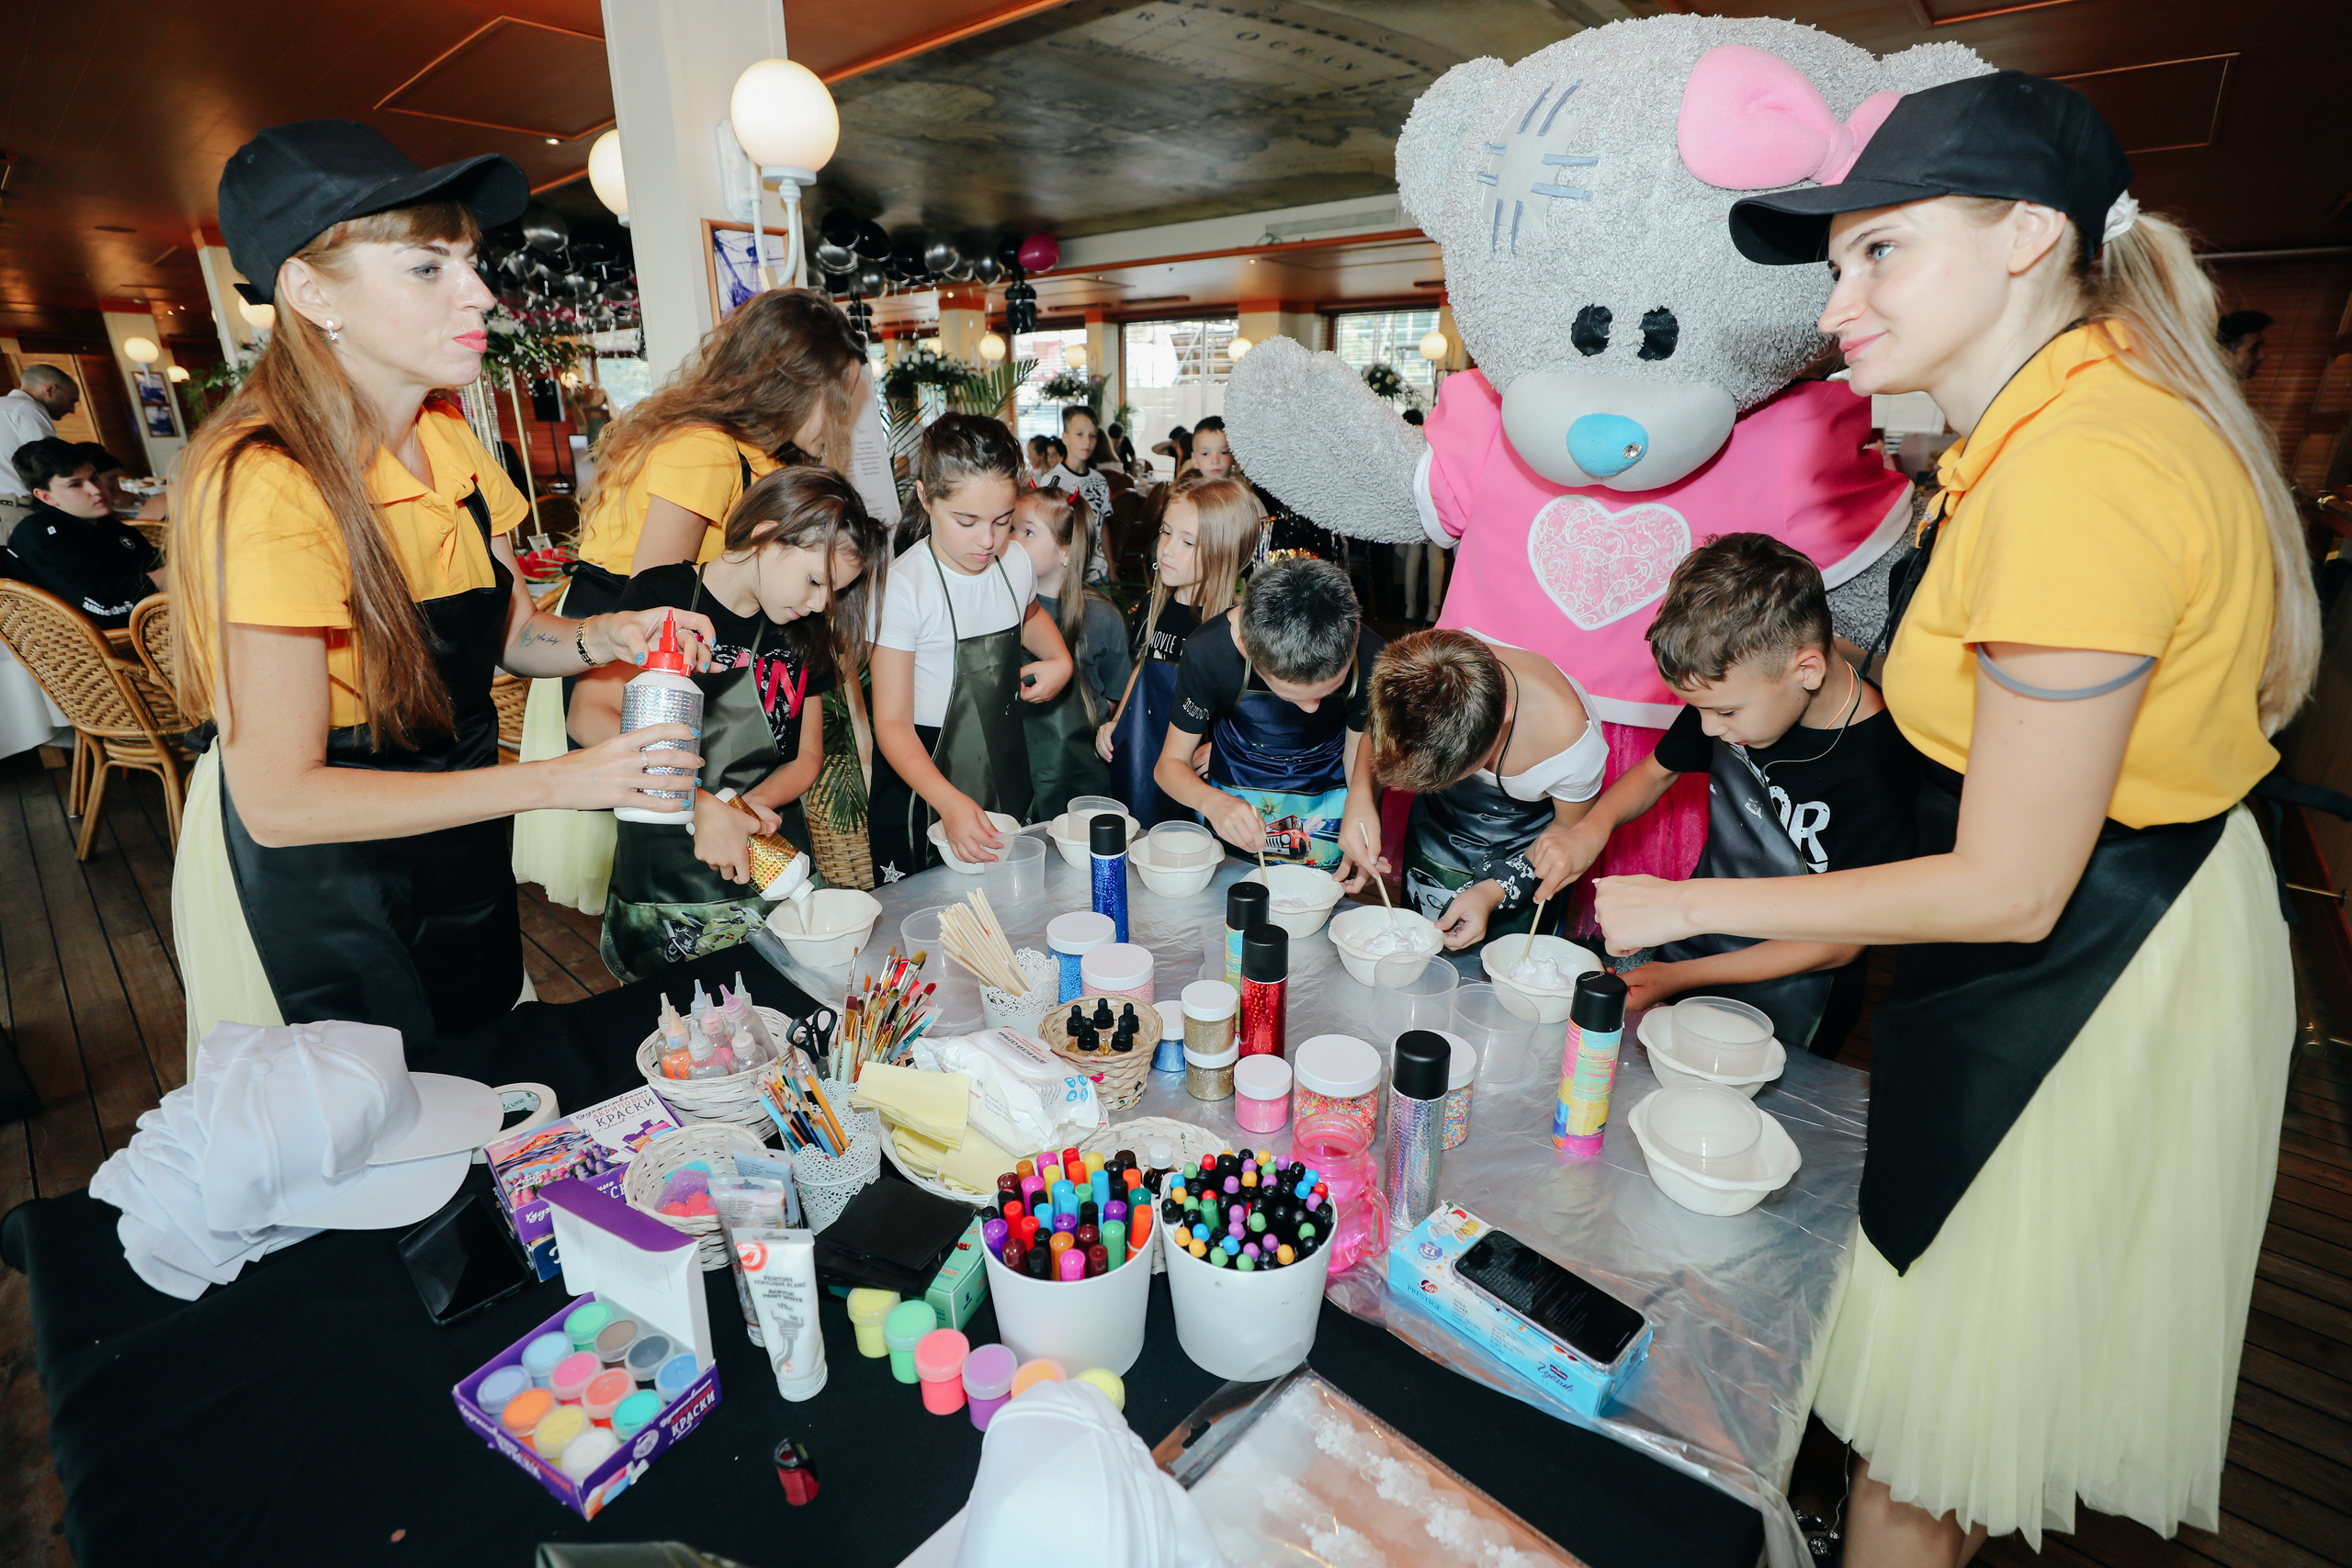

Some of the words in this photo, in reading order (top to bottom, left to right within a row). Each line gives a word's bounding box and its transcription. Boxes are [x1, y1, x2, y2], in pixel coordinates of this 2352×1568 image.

[593, 1093, 650, 1120] АКРИЛОВЫЕ
[595, 1098, 655, 1127] КРАСКИ
[1407, 1284, 1442, 1311] PRESTIGE
[671, 1390, 716, 1438] КРАСКИ
